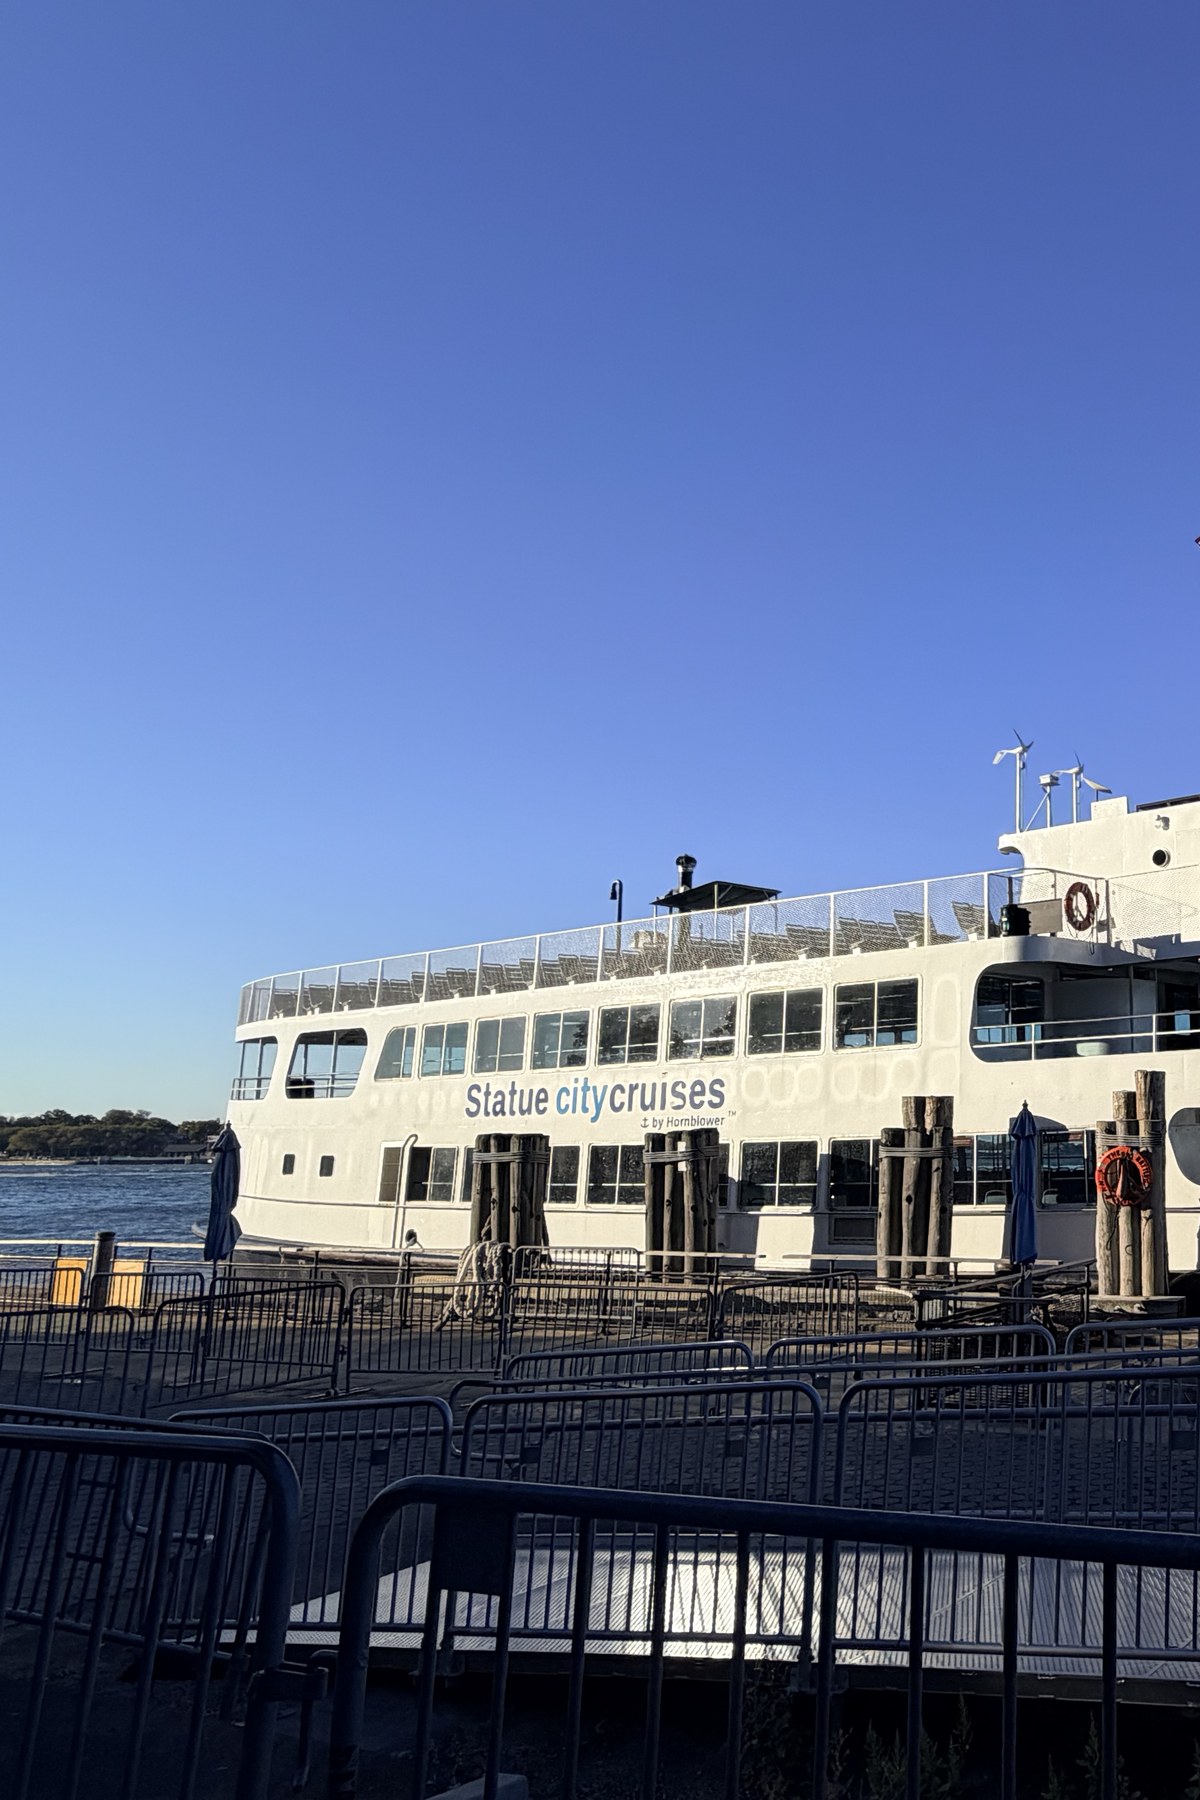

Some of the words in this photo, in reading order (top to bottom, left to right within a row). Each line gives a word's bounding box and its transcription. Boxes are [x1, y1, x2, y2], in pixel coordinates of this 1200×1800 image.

[465, 1081, 549, 1118] Statue
[652, 1116, 664, 1131] by
[666, 1115, 725, 1128] Hornblower
